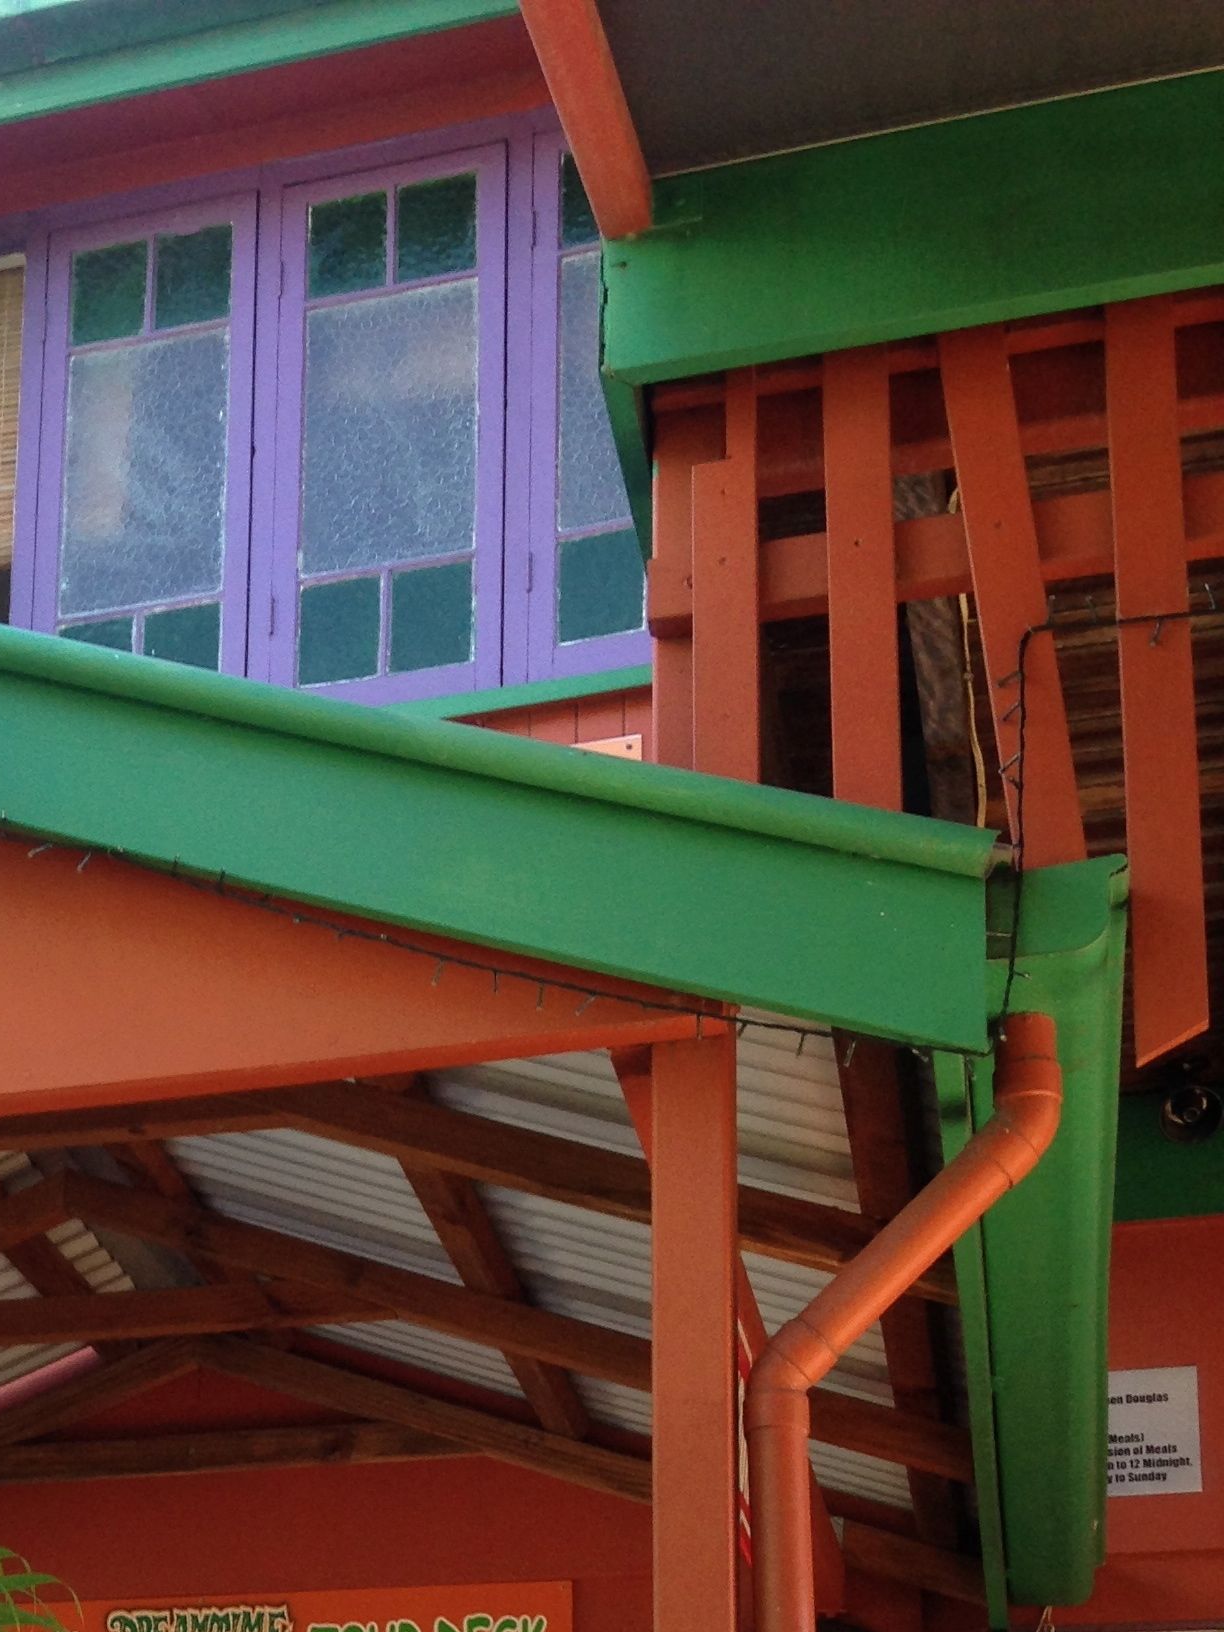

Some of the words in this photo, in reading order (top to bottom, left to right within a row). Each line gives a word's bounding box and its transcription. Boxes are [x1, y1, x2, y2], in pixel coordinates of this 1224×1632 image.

[1126, 1393, 1169, 1403] Douglas
[1108, 1445, 1130, 1456] sion
[1146, 1444, 1177, 1454] Meals
[1117, 1461, 1127, 1470] to
[1130, 1460, 1140, 1468] 12
[1116, 1474, 1125, 1482] to
[1129, 1472, 1167, 1482] Sunday
